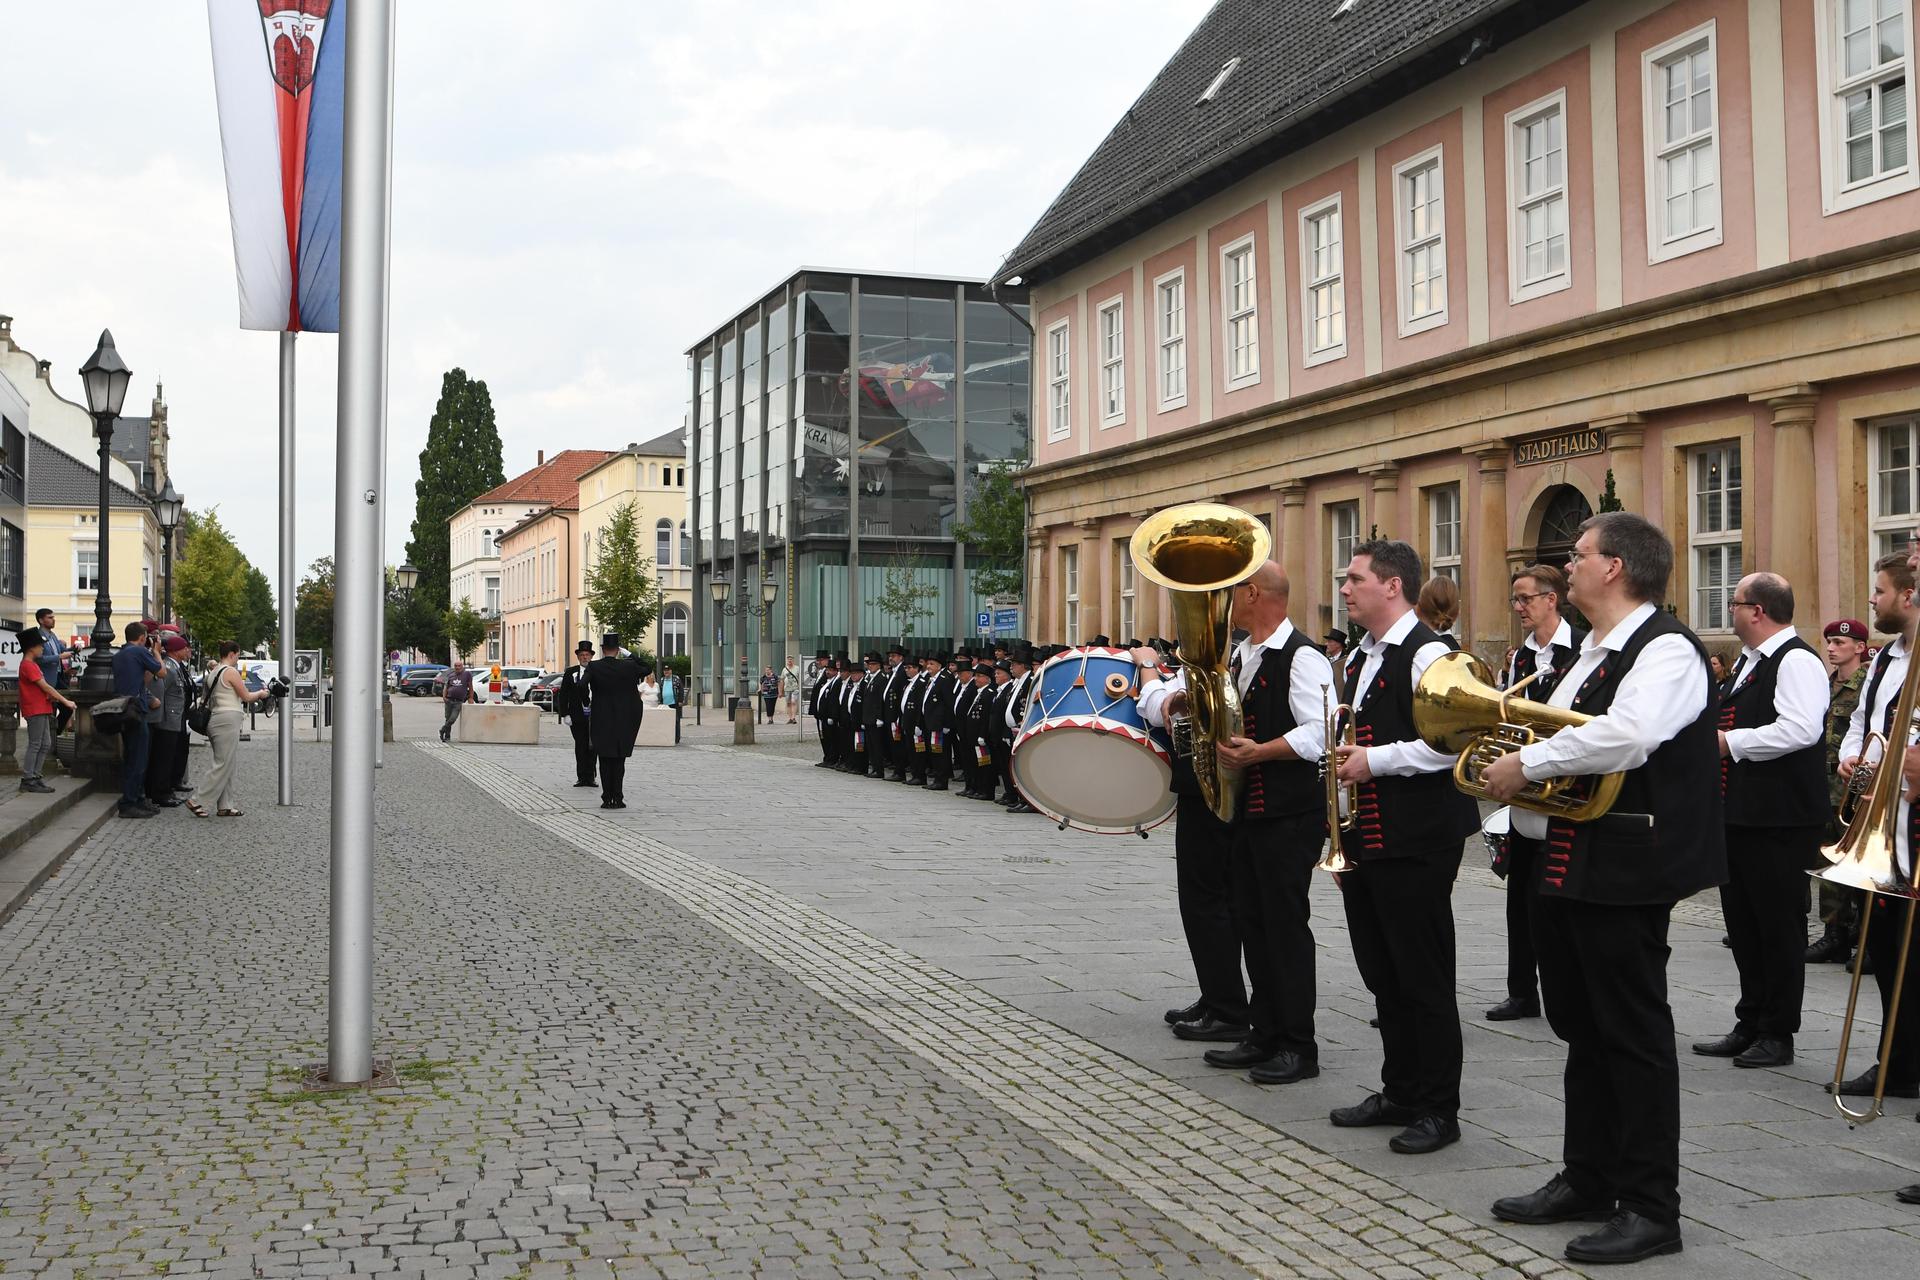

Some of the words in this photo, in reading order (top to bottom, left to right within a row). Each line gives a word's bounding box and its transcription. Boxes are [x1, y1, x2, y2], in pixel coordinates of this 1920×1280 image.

[804, 425, 827, 445] KRA
[1519, 432, 1598, 462] STADTHAUS
[980, 614, 987, 625] P
